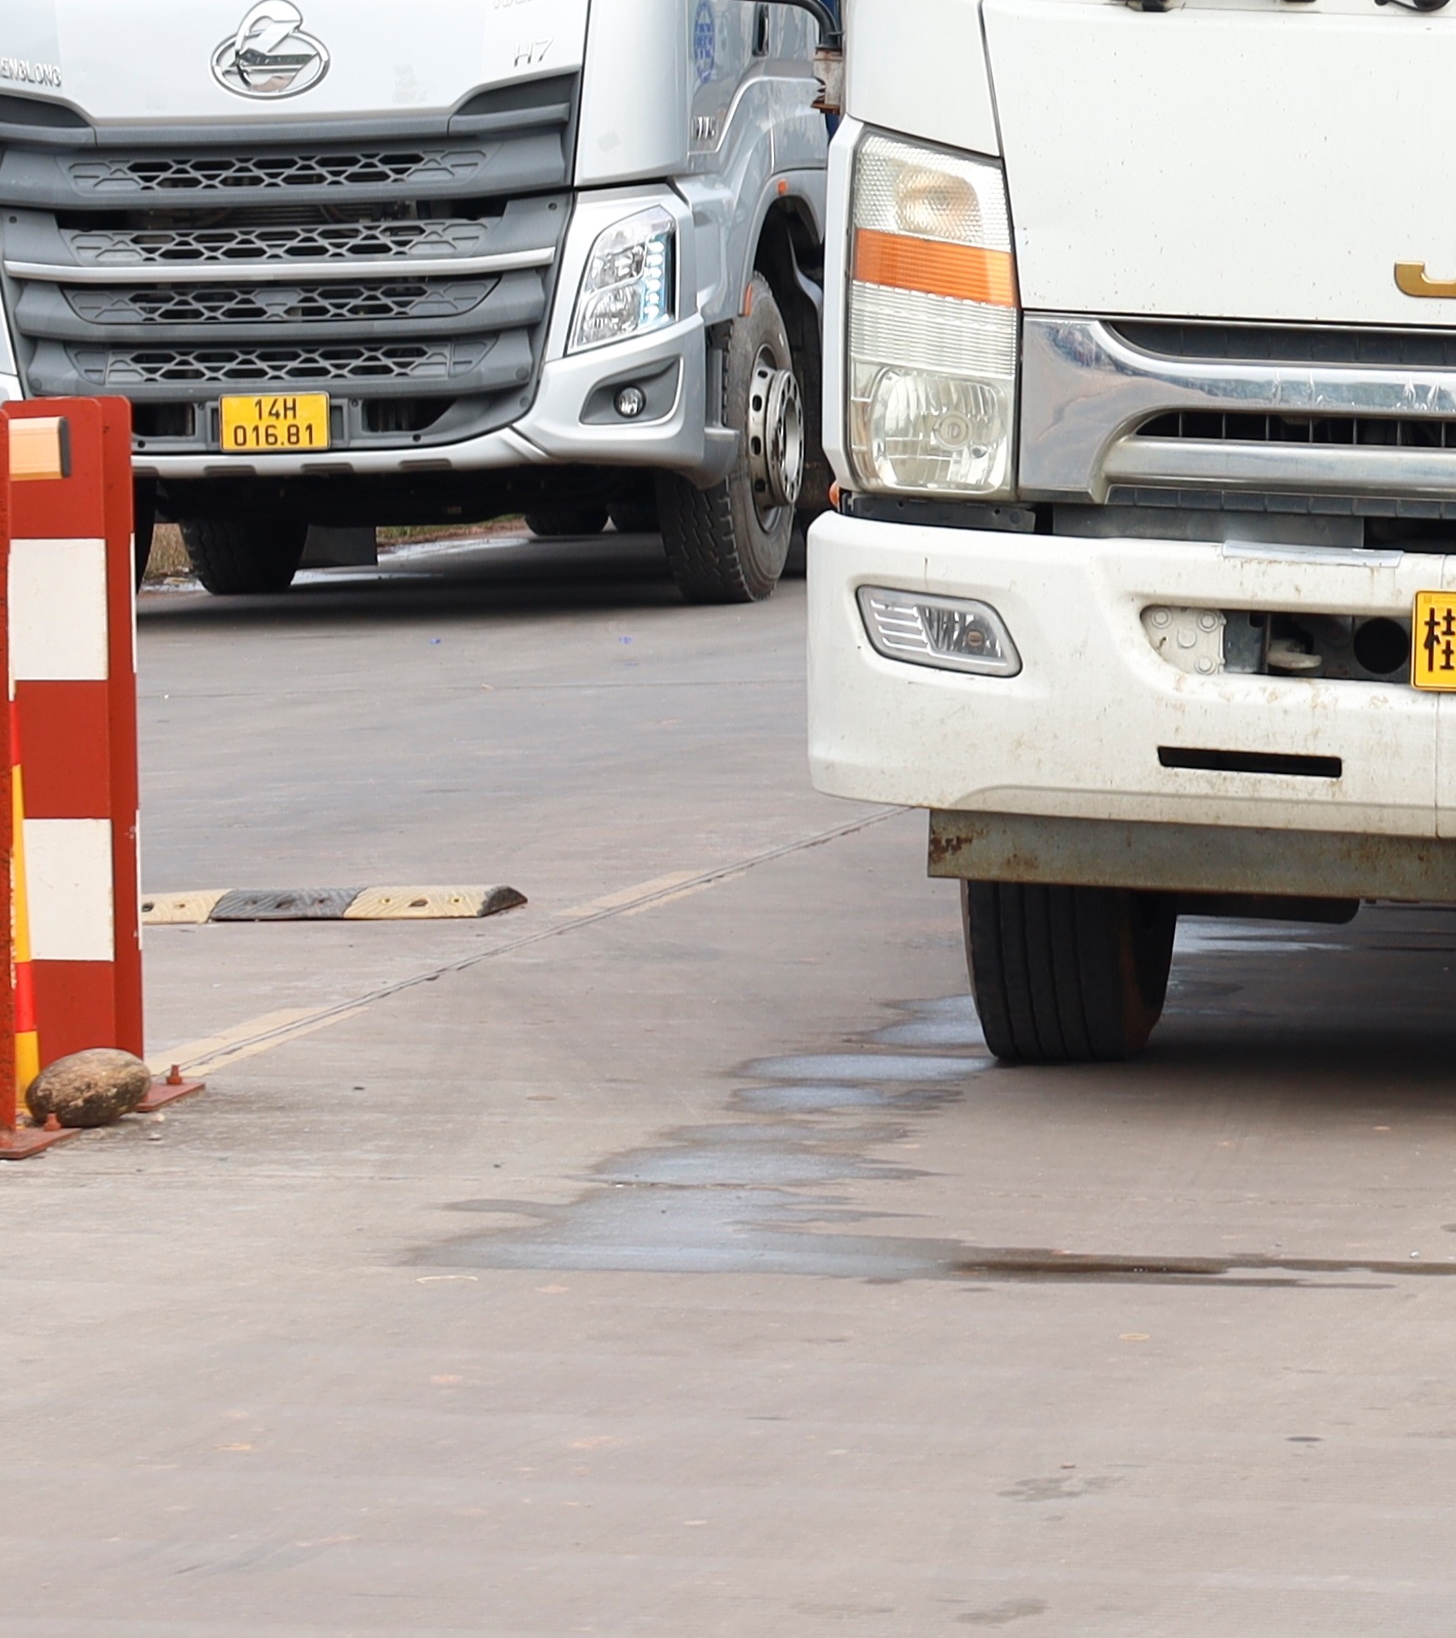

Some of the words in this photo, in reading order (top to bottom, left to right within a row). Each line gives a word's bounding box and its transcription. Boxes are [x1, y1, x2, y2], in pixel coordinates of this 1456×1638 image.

[513, 36, 554, 67] H7
[255, 398, 296, 420] 14H
[234, 423, 313, 446] 016.81
